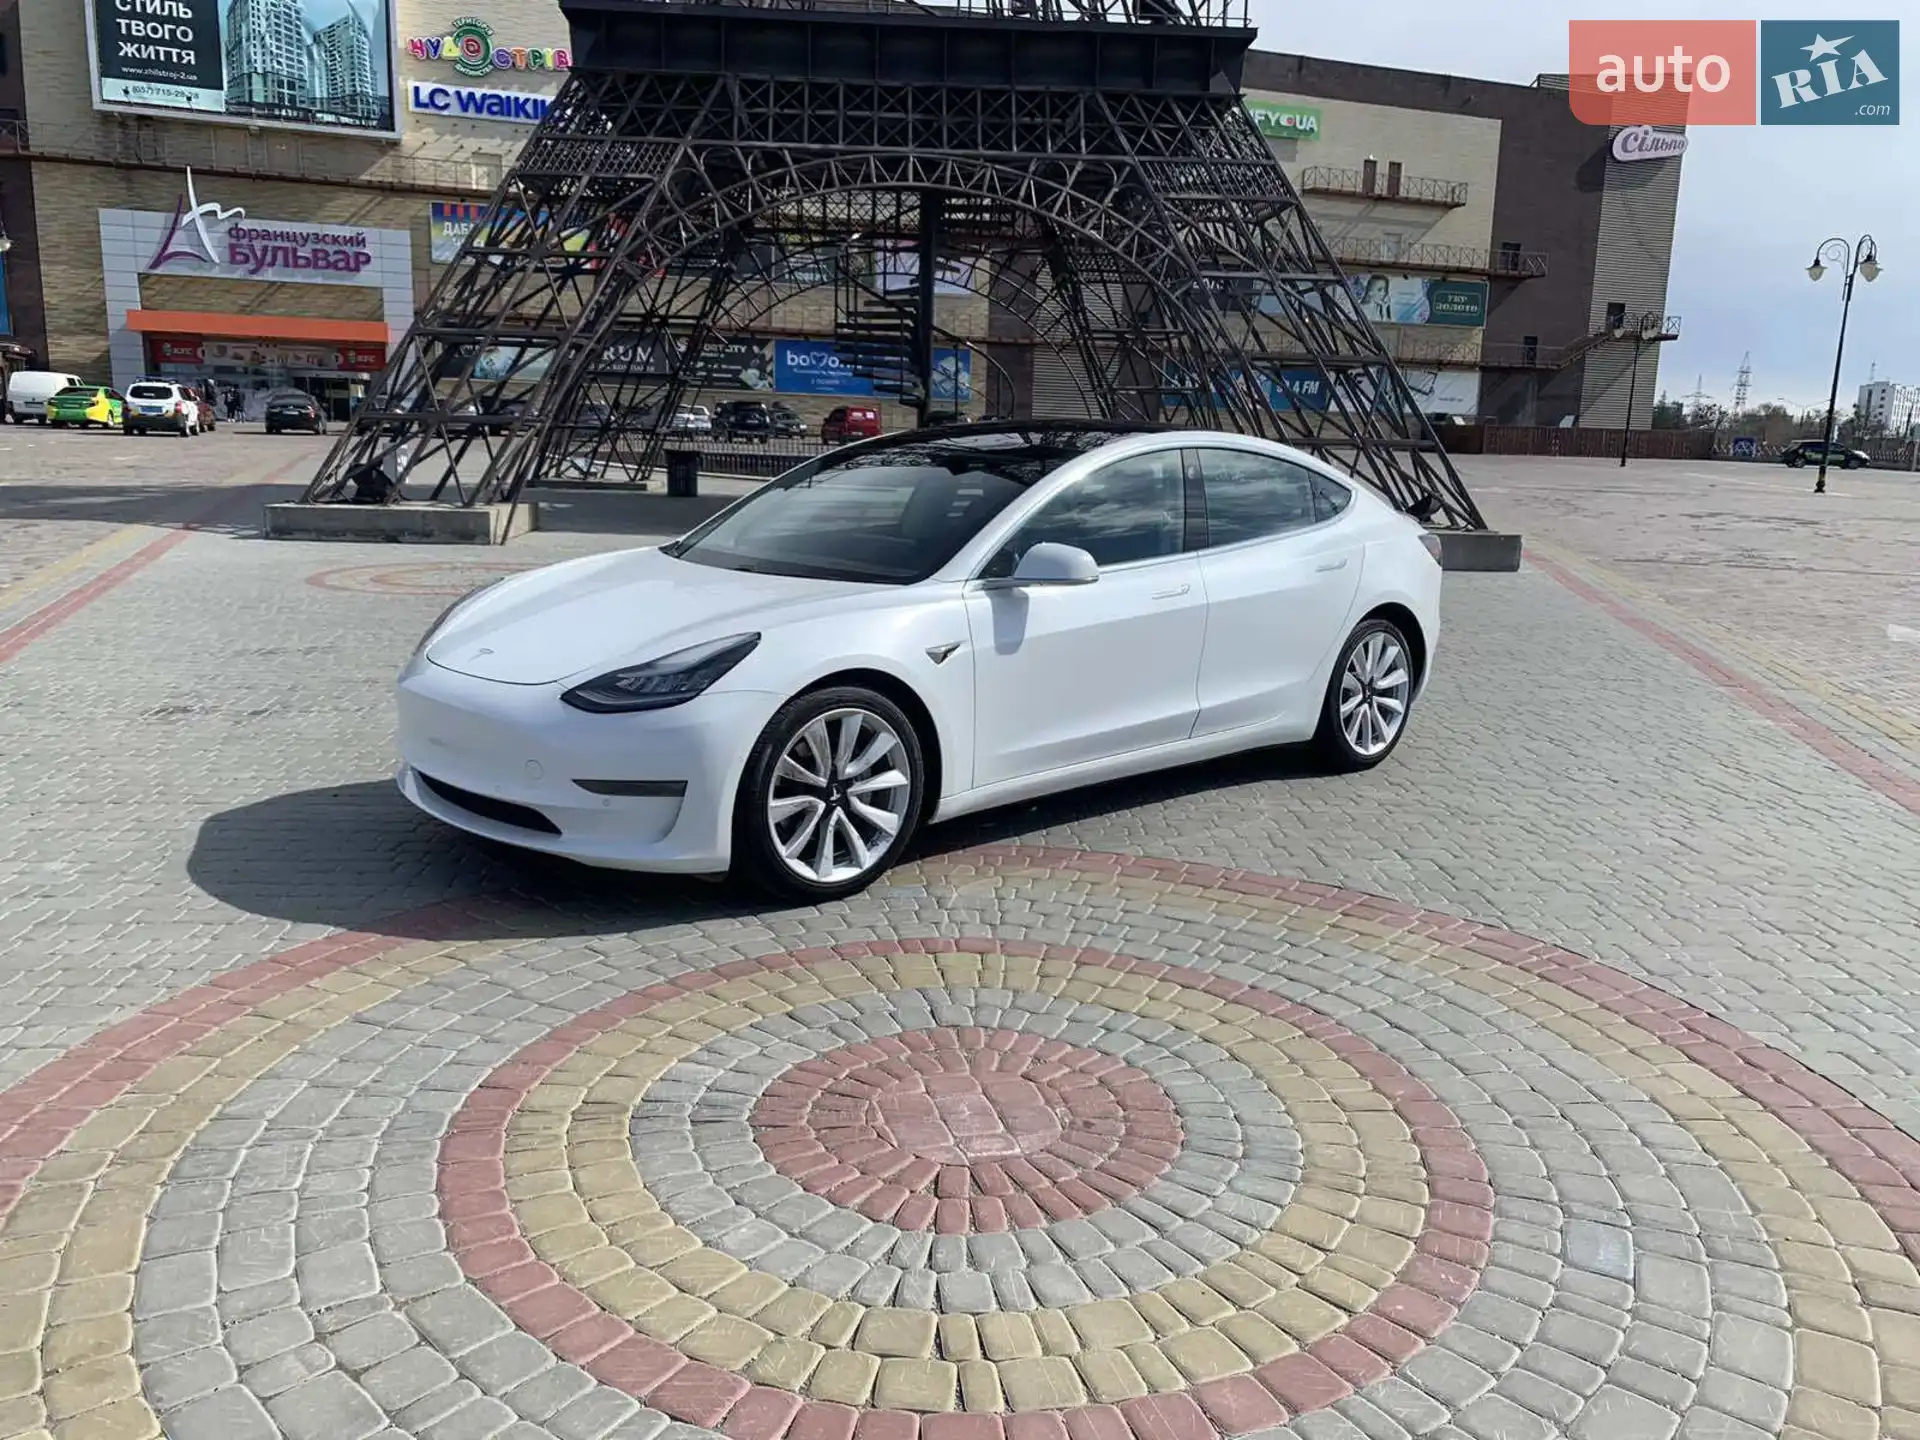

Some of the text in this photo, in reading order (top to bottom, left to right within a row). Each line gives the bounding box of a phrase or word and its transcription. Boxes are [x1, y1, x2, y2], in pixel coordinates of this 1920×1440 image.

[114, 0, 193, 19] СТИЛЬ
[115, 18, 194, 43] ТВОГО
[117, 41, 196, 66] ЖИТТЯ
[121, 66, 198, 81] www.zhilstroj-2.ua
[413, 86, 451, 111] LC
[1621, 130, 1685, 153] Сільпо
[228, 222, 367, 249] французский
[1302, 380, 1320, 395] FM
